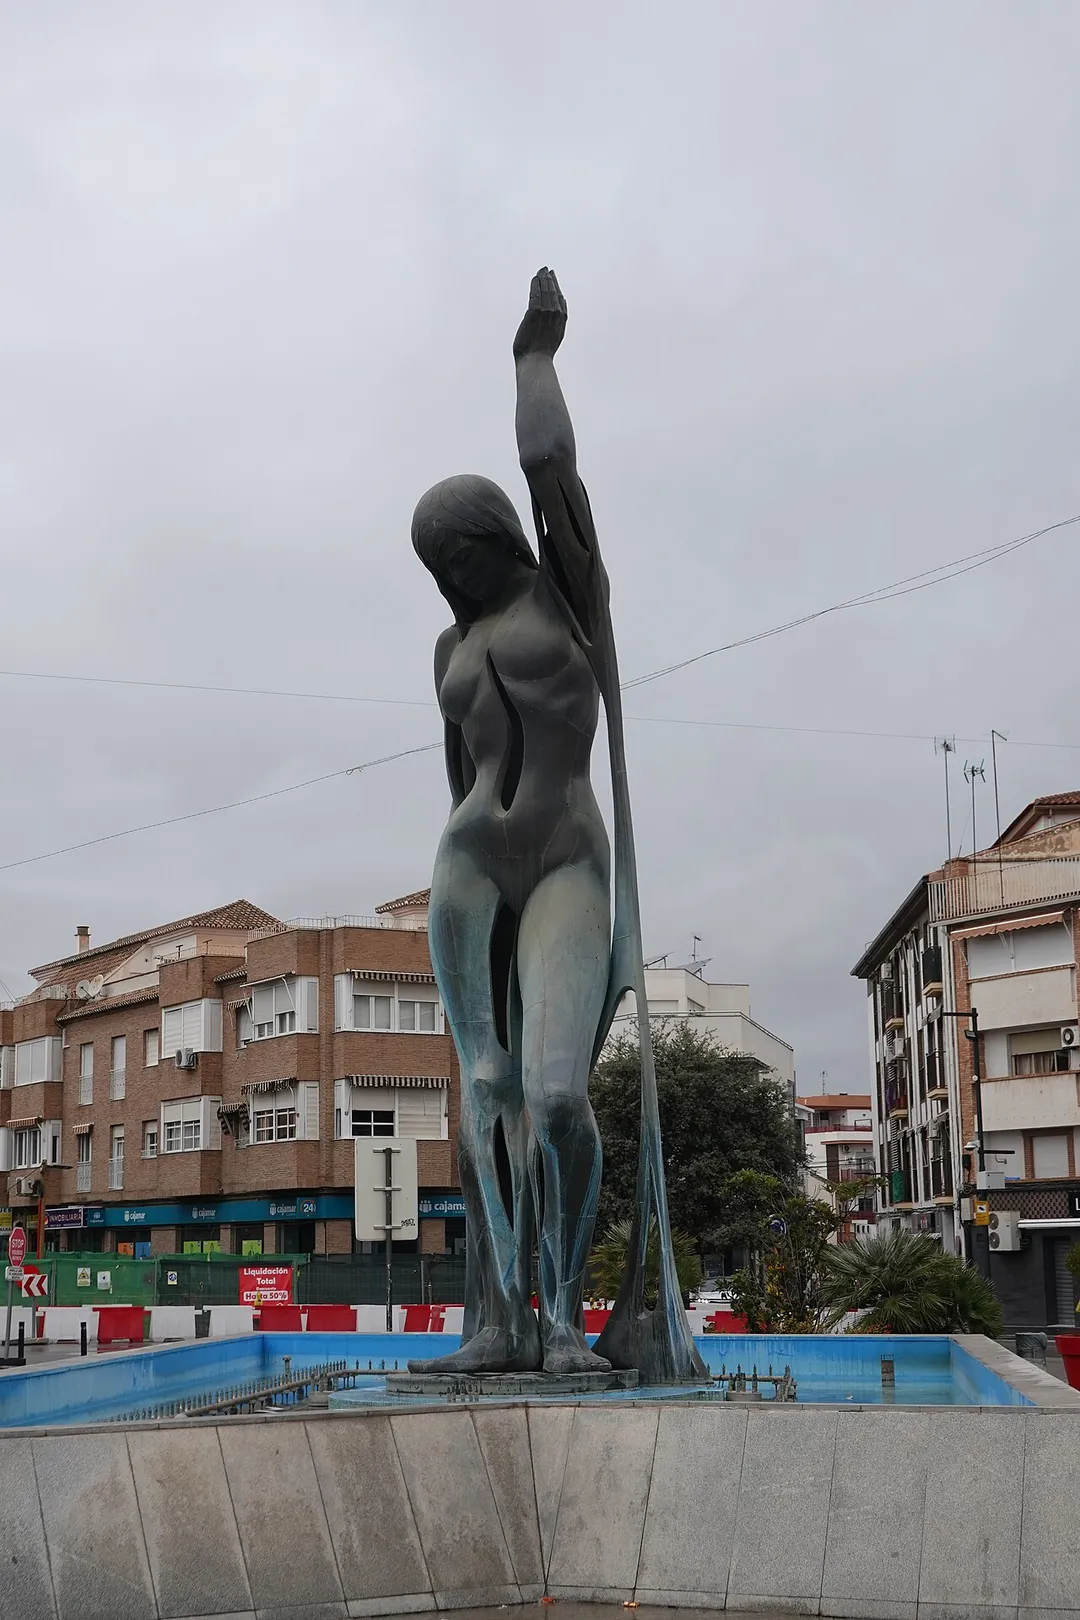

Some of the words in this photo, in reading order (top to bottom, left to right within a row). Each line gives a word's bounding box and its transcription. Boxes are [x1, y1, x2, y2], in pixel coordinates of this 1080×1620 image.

[277, 1204, 296, 1215] cajamar
[434, 1201, 466, 1213] cajama
[49, 1212, 82, 1222] INMOBILIARIA
[130, 1211, 145, 1222] cajamar
[198, 1208, 216, 1219] cajamar
[12, 1239, 24, 1248] STOP
[243, 1267, 288, 1276] Liquidación
[256, 1277, 276, 1285] Total
